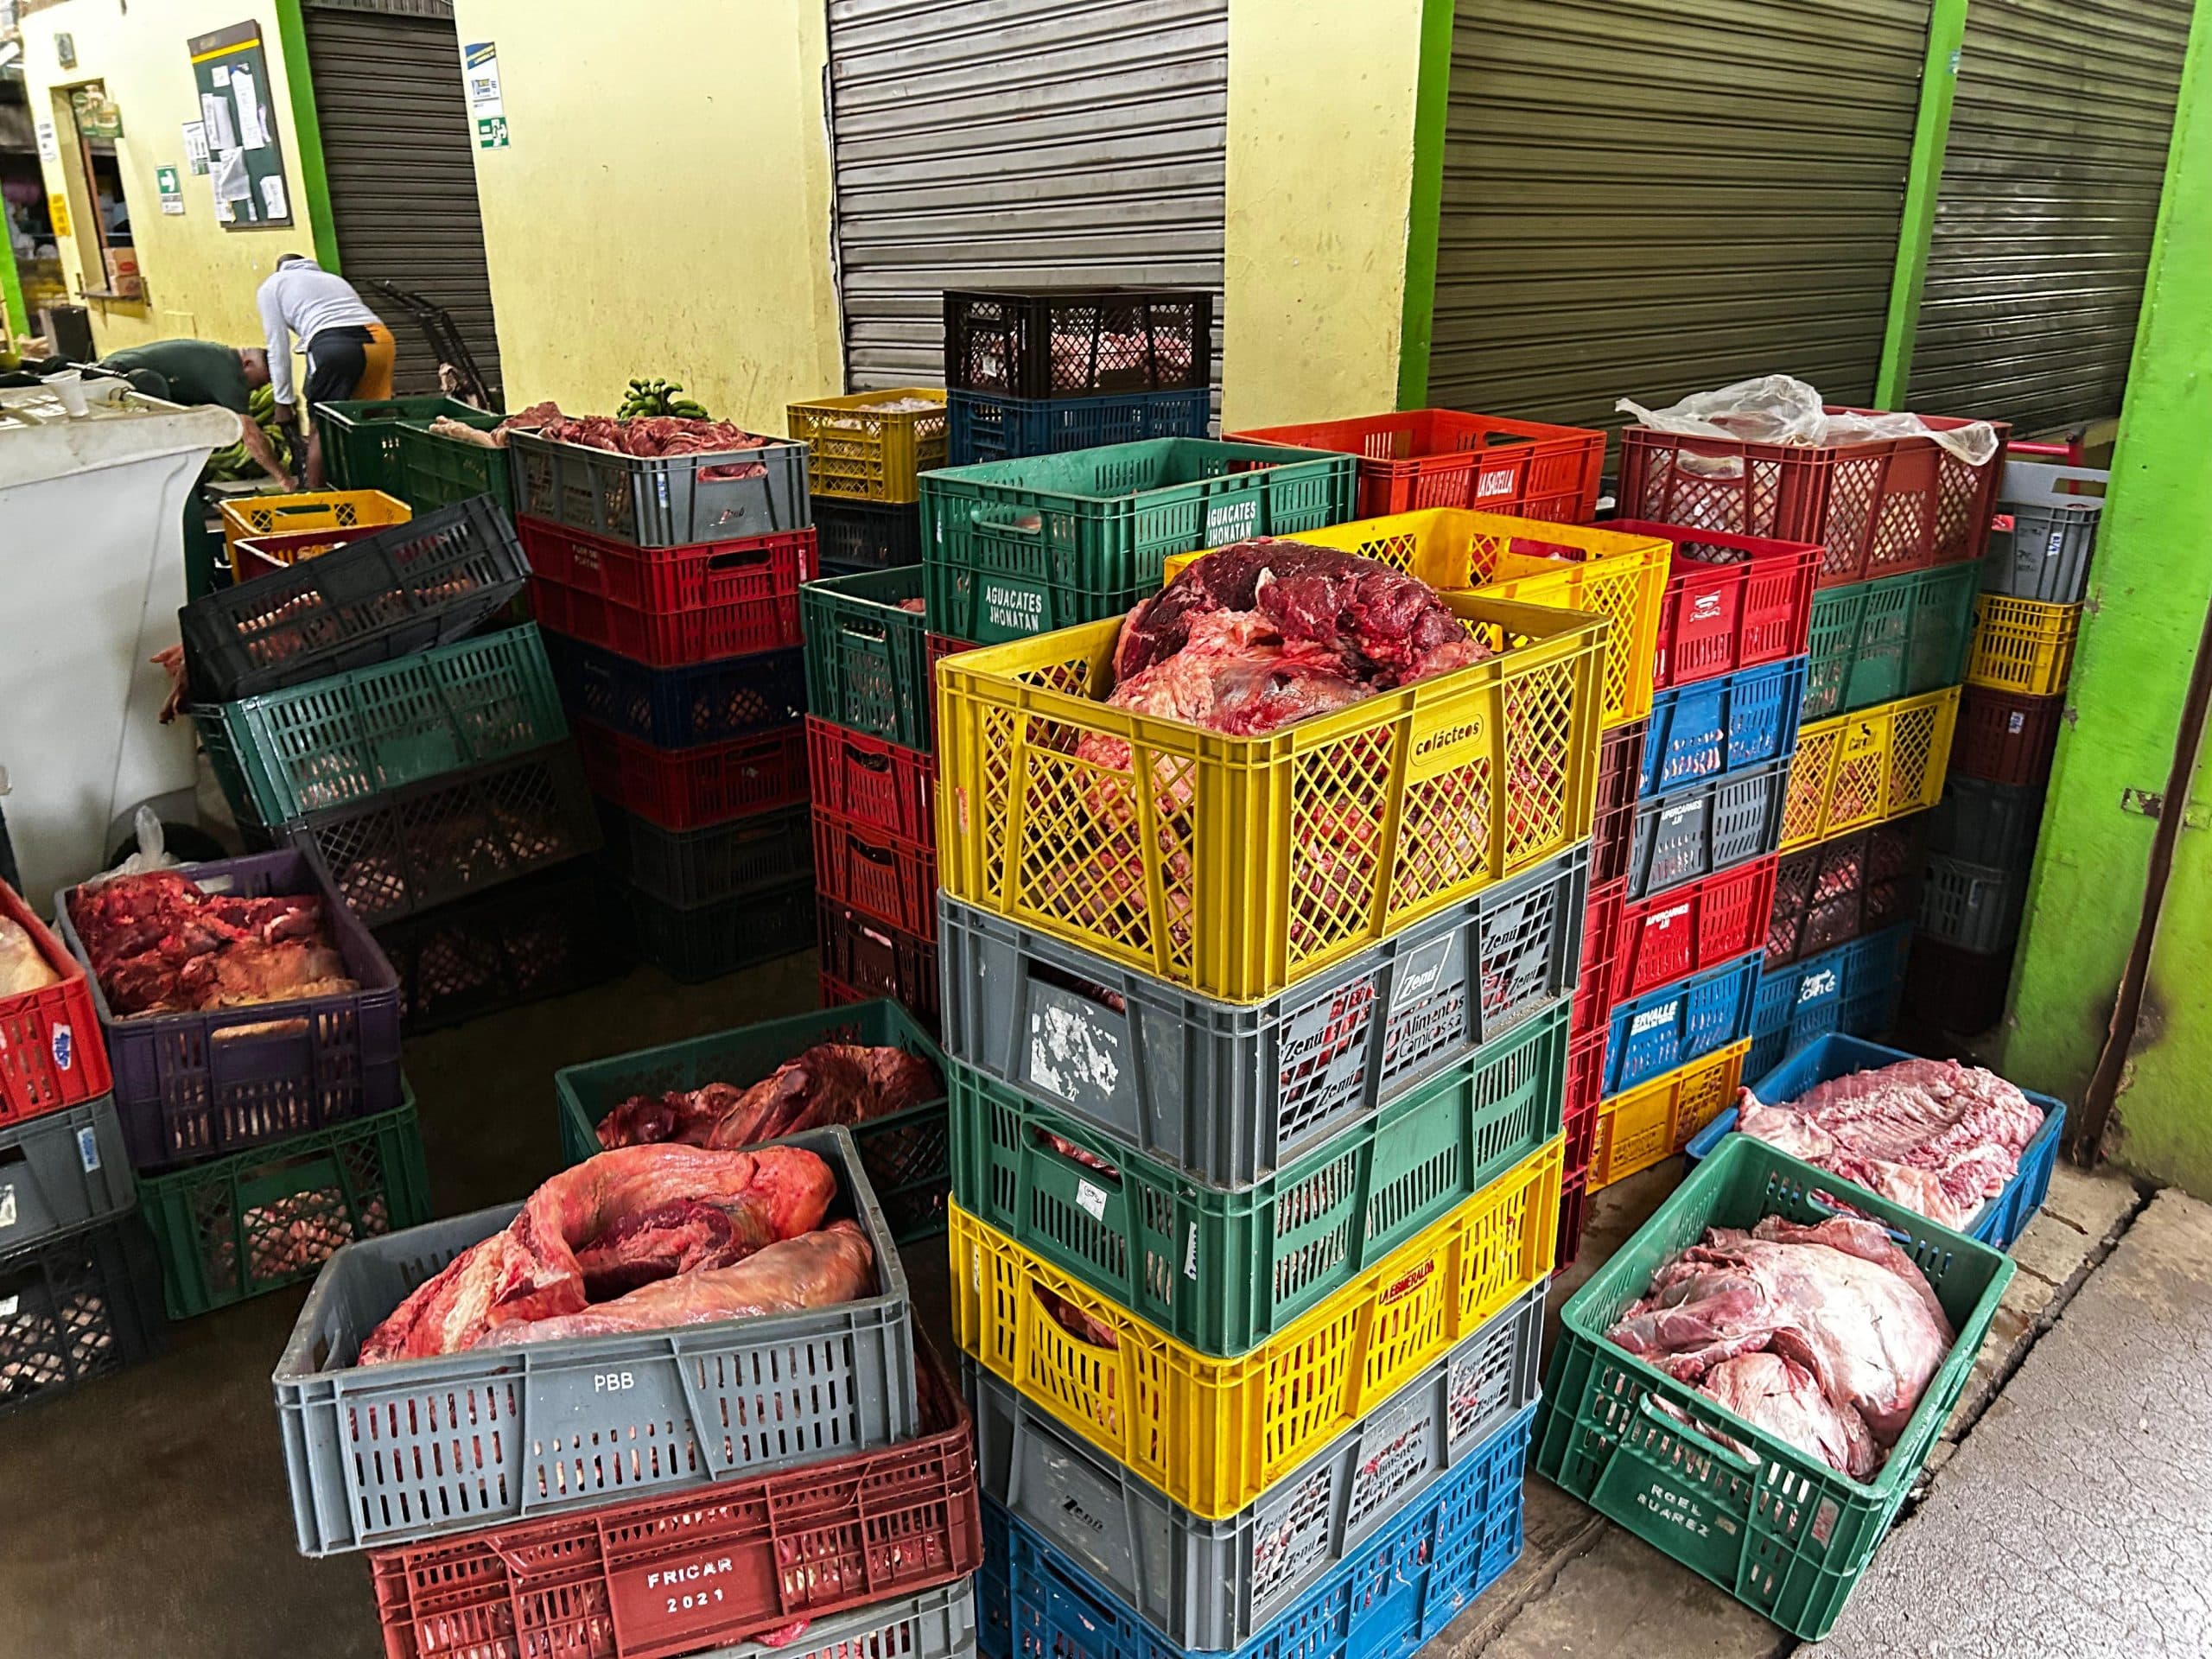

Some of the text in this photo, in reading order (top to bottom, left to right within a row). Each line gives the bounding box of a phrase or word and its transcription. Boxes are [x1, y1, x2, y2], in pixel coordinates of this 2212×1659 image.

[1206, 500, 1257, 528] AGUACATES
[1207, 521, 1252, 548] JHONATAN
[985, 585, 1043, 614] AGUACATES
[988, 605, 1039, 632] JHONATAN
[1415, 721, 1480, 756] colácteos
[1482, 924, 1519, 957] Zenú
[1398, 963, 1439, 1001] Zenú
[1402, 995, 1465, 1041] Alimentos
[1281, 1027, 1325, 1066] Zenú
[1317, 1071, 1356, 1109] Zenú
[1389, 1259, 1435, 1298] ESMERALDA
[594, 1371, 635, 1393] PBB
[1637, 1492, 1711, 1538] SUAREZ
[1650, 1483, 1702, 1517] ROEL
[647, 1556, 734, 1590] FRICAR
[666, 1588, 724, 1614] 2021
